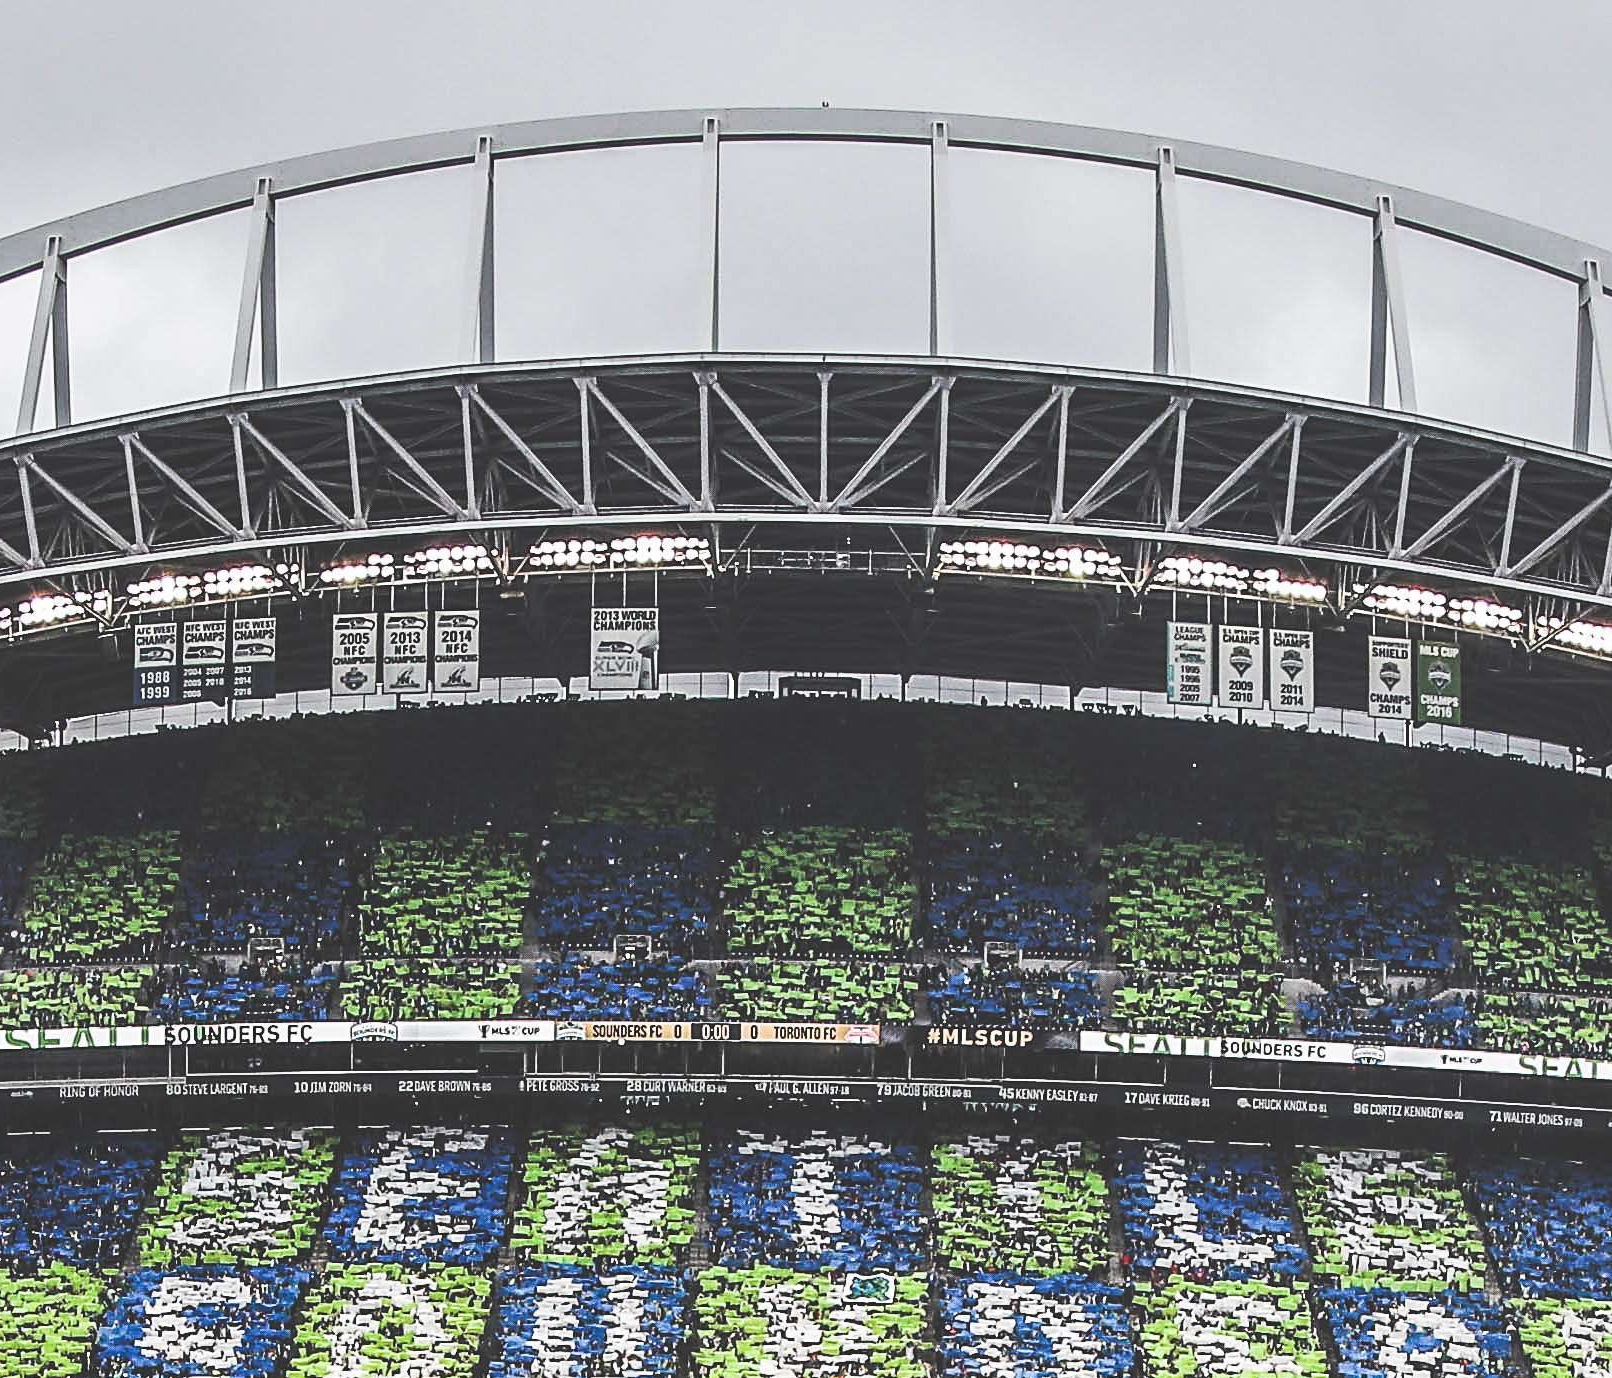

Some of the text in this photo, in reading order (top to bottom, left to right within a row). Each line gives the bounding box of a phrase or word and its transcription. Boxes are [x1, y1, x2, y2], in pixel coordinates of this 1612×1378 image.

[594, 610, 656, 620] 2013 WORLD
[203, 623, 224, 631] WEST
[253, 620, 274, 628] WEST
[593, 621, 656, 631] CHAMPIONS
[1176, 626, 1204, 634] LEAGUE
[136, 635, 175, 646] CHAMPS
[185, 632, 224, 643] CHAMPS
[234, 629, 274, 640] CHAMPS
[339, 633, 369, 645] 2005
[390, 632, 420, 644] 2013
[442, 631, 472, 643] 2014
[1174, 633, 1206, 642] CHAMPS
[1222, 634, 1260, 645] CHAMPS
[446, 644, 468, 653] NFC
[1273, 638, 1310, 649] CHAMPS
[344, 646, 366, 655] NFC
[394, 645, 416, 655] NFC
[1372, 647, 1408, 659] SHIELD
[1420, 645, 1459, 658] MLS CUP
[593, 660, 638, 672] XLVIII
[140, 671, 170, 684] 1988
[1229, 680, 1254, 691] 2009
[1280, 684, 1303, 695] 2011
[140, 686, 170, 699] 1999
[1229, 692, 1253, 703] 2010
[1280, 695, 1304, 706] 2014
[1370, 693, 1410, 705] CHAMPS
[1421, 694, 1460, 707] CHAMPS
[1379, 704, 1402, 714] 2014
[1426, 705, 1452, 718] 2016
[165, 1024, 312, 1045] SOUNDERS FC
[492, 1027, 540, 1035] MLS CUP
[593, 1025, 837, 1040] SOUNDERS FC 0 0:00 0 TORONTO FC
[927, 1027, 1034, 1047] #MLSCUP
[1221, 1039, 1326, 1059] SOUNDERS FC
[59, 1084, 138, 1098] RING OF HONOR
[166, 1082, 247, 1096] 80 STEVE LARGENT
[294, 1081, 351, 1094] 10 JIM ZORN
[398, 1080, 470, 1092] 22 DAVE BROWN
[526, 1080, 579, 1092] PETE GROSS
[627, 1081, 705, 1093] 28 CURT WARNER
[768, 1082, 830, 1095] PAUL G. ALLEN
[877, 1084, 951, 1098] 79 JACOB GREEN
[999, 1087, 1079, 1102] 45 KENNY EASLEY
[1125, 1091, 1190, 1106] 17 DAVE KRIEG
[1253, 1098, 1307, 1112] CHUCK KNOX
[1353, 1102, 1444, 1119] 96 CORTEZ KENNEDY
[1489, 1110, 1564, 1127] 71 WALTER JONES
